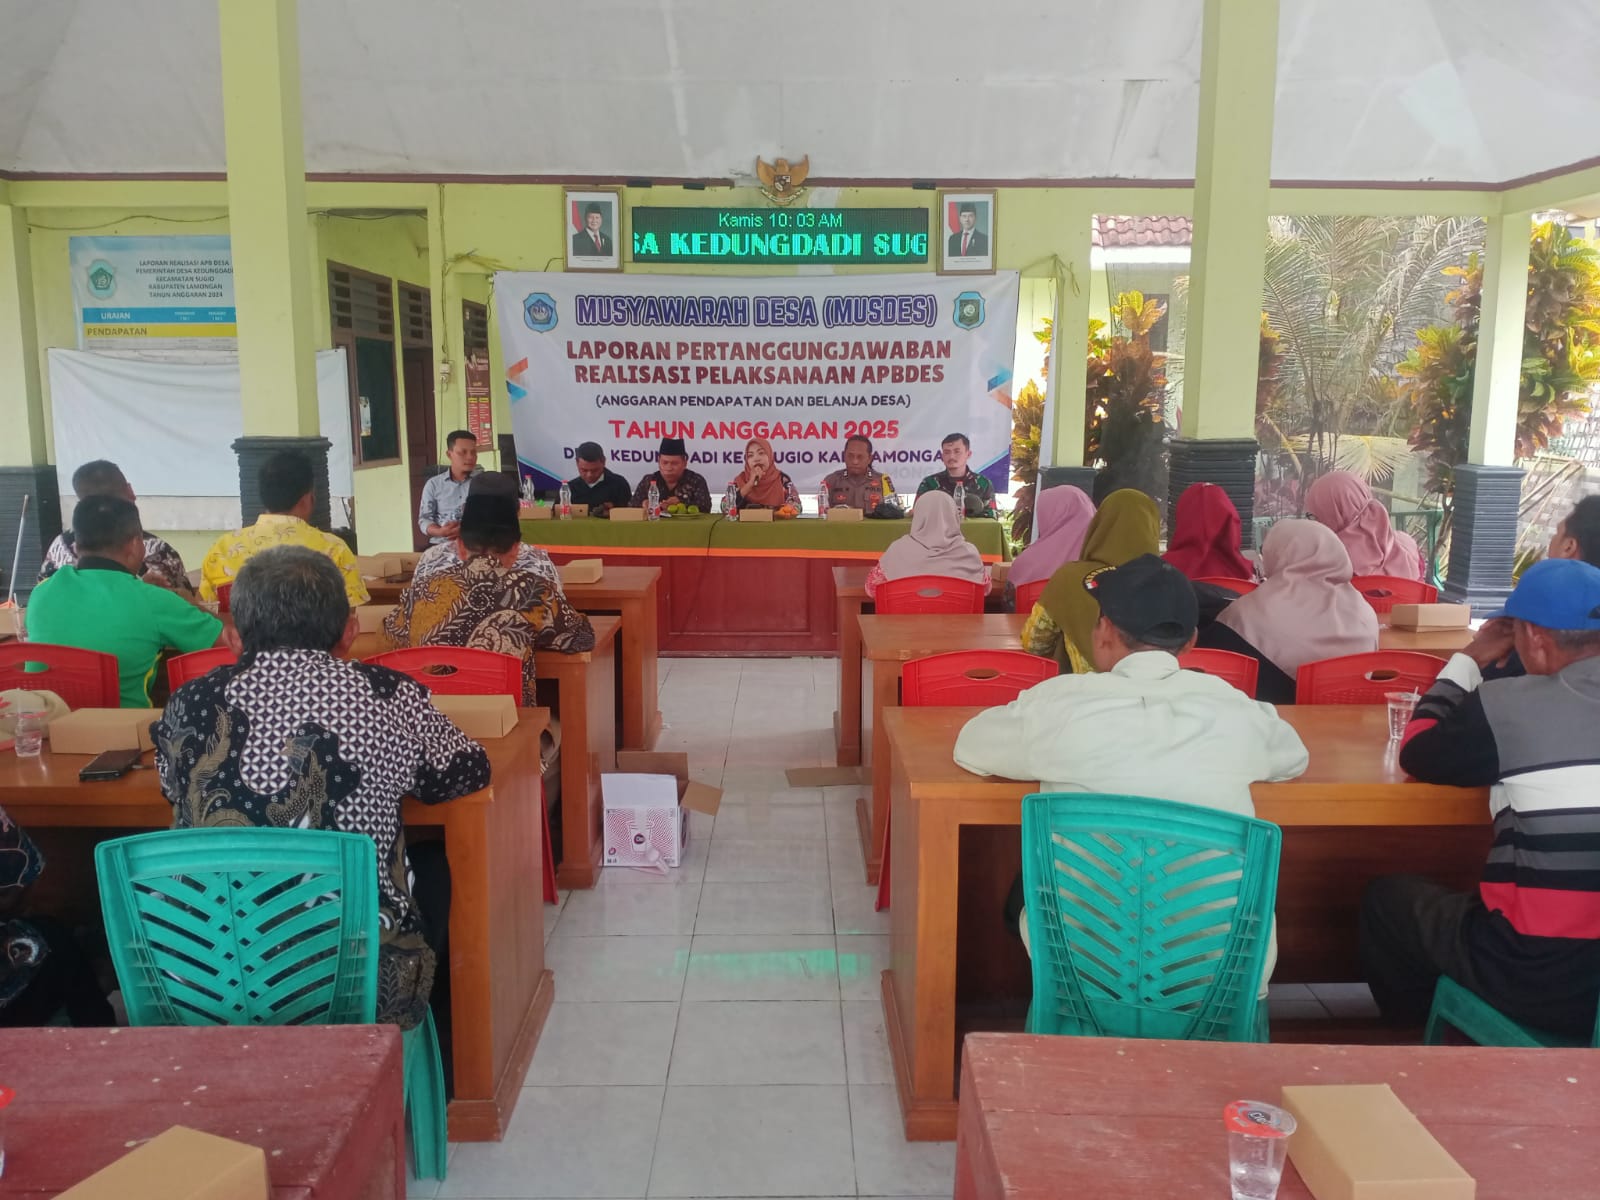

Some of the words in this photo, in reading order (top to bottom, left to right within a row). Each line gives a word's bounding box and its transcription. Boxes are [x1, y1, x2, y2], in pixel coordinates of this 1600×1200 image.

[719, 213, 763, 227] Kamis
[796, 213, 815, 227] 03
[818, 213, 842, 227] AM
[670, 232, 861, 256] KEDUNGDADI
[100, 312, 131, 320] URAIAN
[575, 294, 750, 327] MUSYAWARAH
[754, 295, 819, 327] DESA
[823, 294, 938, 328] (MUSDES)
[87, 327, 148, 337] PENDAPATAN
[566, 340, 671, 360] LAPORAN
[676, 340, 951, 361] PERTANGGUNGJAWABAN
[574, 364, 691, 384] REALISASI
[695, 365, 855, 385] PELAKSANAAN
[860, 364, 944, 384] APBDES
[595, 394, 677, 409] (ANGGARAN
[680, 395, 772, 407] PENDAPATAN
[775, 396, 804, 407] DAN
[807, 395, 868, 407] BELANJA
[870, 394, 911, 409] DESA)
[608, 420, 695, 440] TAHUN
[701, 420, 838, 440] ANGGARAN
[843, 419, 900, 439] 2025
[723, 451, 747, 464] KE
[773, 451, 814, 464] UGIO
[818, 451, 846, 464] KA
[872, 450, 946, 464] AMONGA
